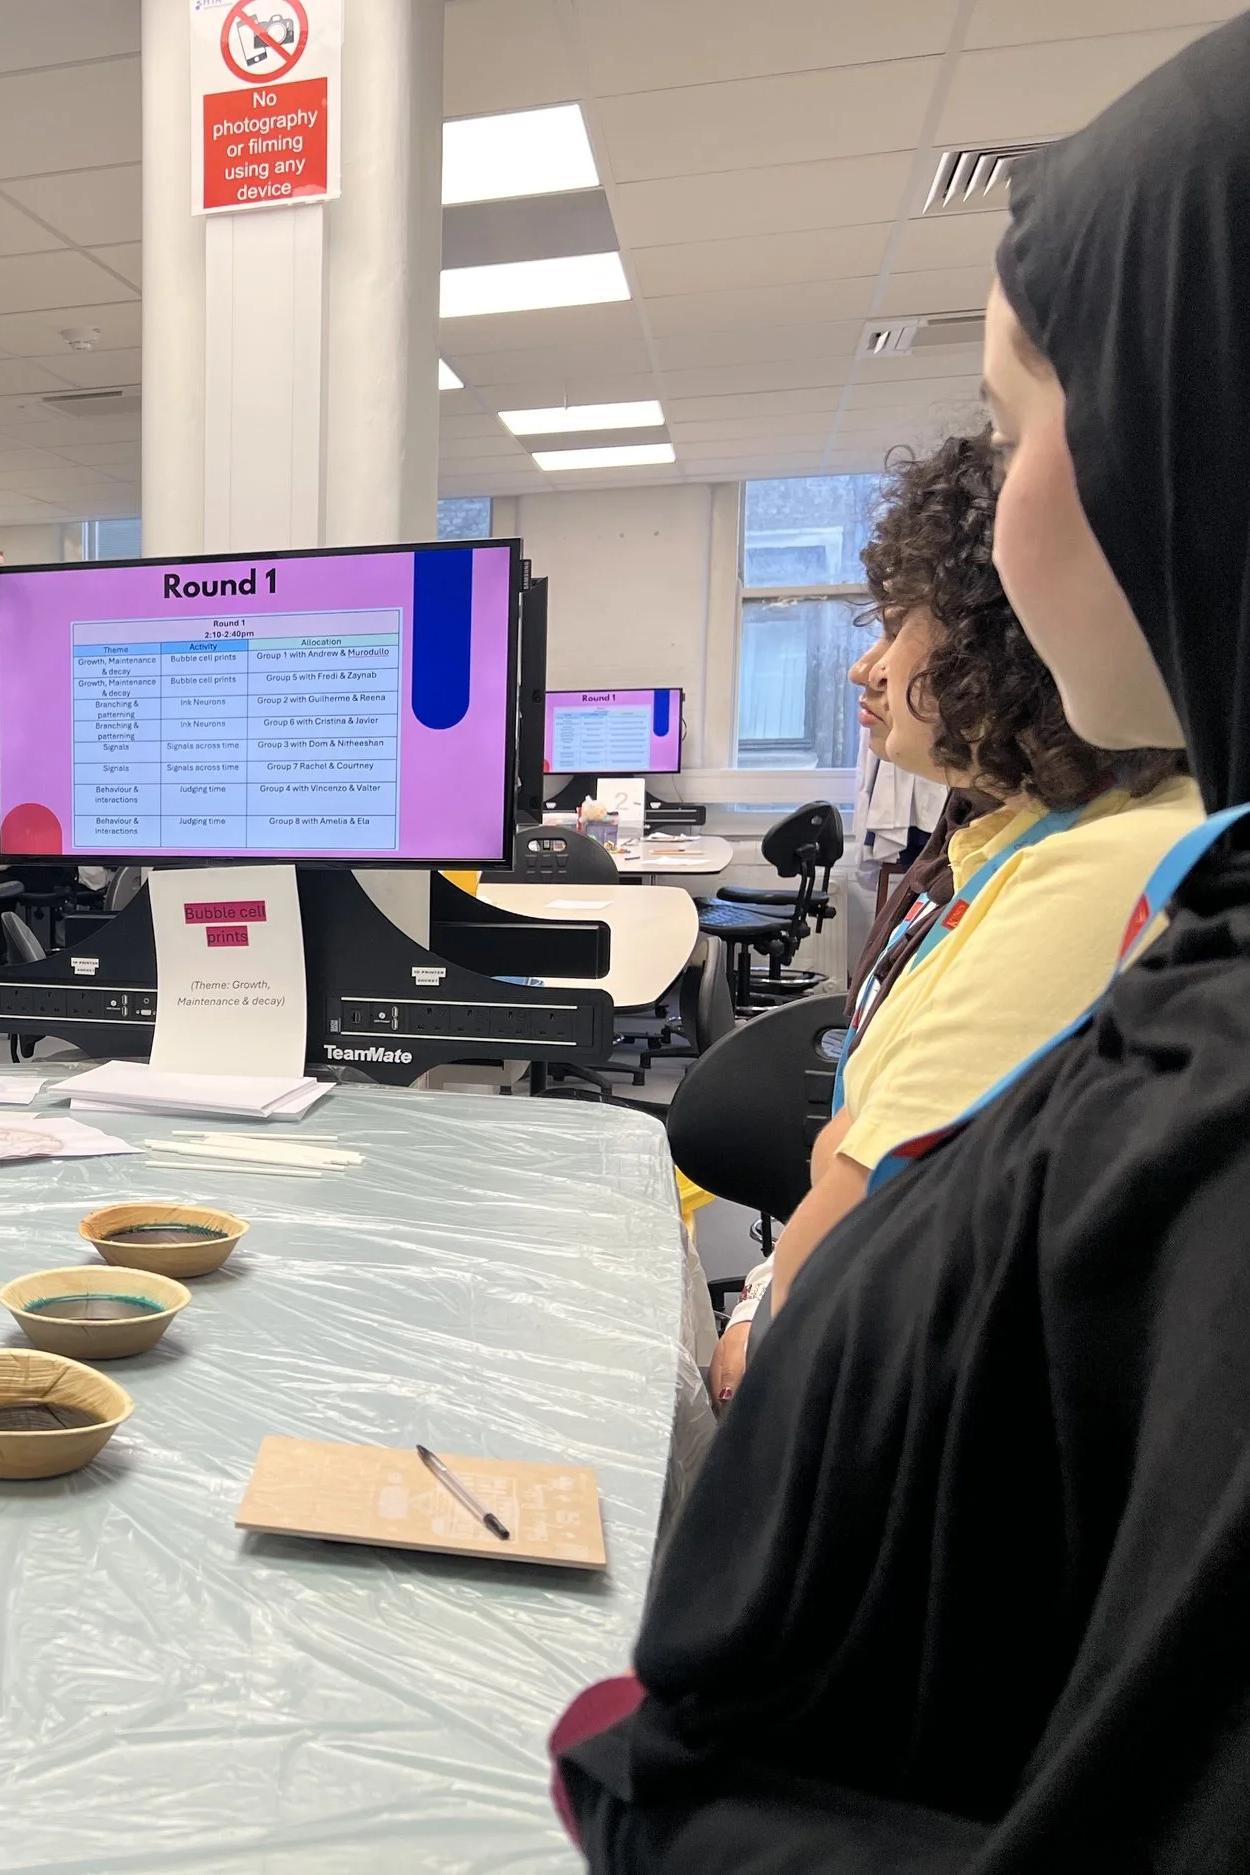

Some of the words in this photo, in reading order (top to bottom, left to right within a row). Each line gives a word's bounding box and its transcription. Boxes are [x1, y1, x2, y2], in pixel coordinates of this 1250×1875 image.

[252, 91, 277, 108] No
[213, 109, 318, 140] photography
[226, 143, 245, 158] or
[248, 135, 303, 154] filming
[224, 162, 269, 180] using
[274, 158, 306, 175] any
[237, 181, 292, 201] device
[164, 568, 256, 598] Round
[265, 568, 276, 594] 1
[213, 620, 239, 628] Round
[204, 630, 254, 639] 2:10-2:40pm
[301, 638, 342, 646] Allocation
[103, 646, 129, 654] Theme
[189, 643, 218, 652] Activity
[214, 654, 237, 663] prints
[256, 652, 281, 660] Group
[308, 650, 338, 658] Andrew
[78, 657, 107, 666] Growth,
[108, 656, 156, 665] Maintenance
[108, 668, 131, 677] decay
[266, 674, 291, 682] Group
[299, 673, 316, 681] with
[318, 672, 338, 680] Fredi
[347, 671, 377, 681] Zaynab
[78, 679, 107, 687] Growth,
[108, 678, 156, 687] Maintenance
[170, 677, 197, 685] Bubble
[199, 676, 213, 684] cell
[214, 676, 237, 684] prints
[108, 689, 131, 698] decay
[581, 694, 610, 702] Round
[612, 693, 616, 701] 1
[257, 697, 282, 705] Group
[360, 694, 386, 702] Reena
[95, 701, 133, 709] Branching
[97, 711, 135, 720] patterning
[95, 722, 133, 730] Branching
[193, 720, 226, 728] Neurons
[263, 719, 288, 727] Group
[289, 718, 295, 726] 6
[315, 717, 346, 725] Cristina
[97, 733, 135, 741] patterning
[103, 743, 129, 752] Signals
[167, 742, 194, 751] Signals
[258, 741, 282, 749] Group
[290, 740, 307, 748] with
[103, 765, 129, 773] Signals
[167, 764, 194, 773] Signals
[267, 763, 292, 771] Group
[300, 762, 327, 770] Rachel
[336, 762, 374, 771] Courtney
[180, 786, 208, 794] Judging
[260, 785, 284, 793] Group
[292, 784, 309, 792] with
[95, 796, 138, 804] interactions
[615, 792, 629, 810] 2
[179, 818, 208, 826] Judging
[269, 818, 294, 826] Group
[295, 817, 300, 825] 8
[301, 817, 319, 825] with
[320, 817, 348, 825] Amelia
[357, 817, 370, 825] Ela
[185, 905, 236, 920] Bubble
[239, 904, 266, 918] cell
[207, 929, 248, 945] prints
[190, 980, 230, 991] (Theme:
[232, 980, 271, 990] Growth,
[177, 996, 240, 1007] Maintenance
[241, 996, 249, 1006] &
[252, 996, 286, 1007] decay)
[323, 1044, 413, 1064] TeamMate
